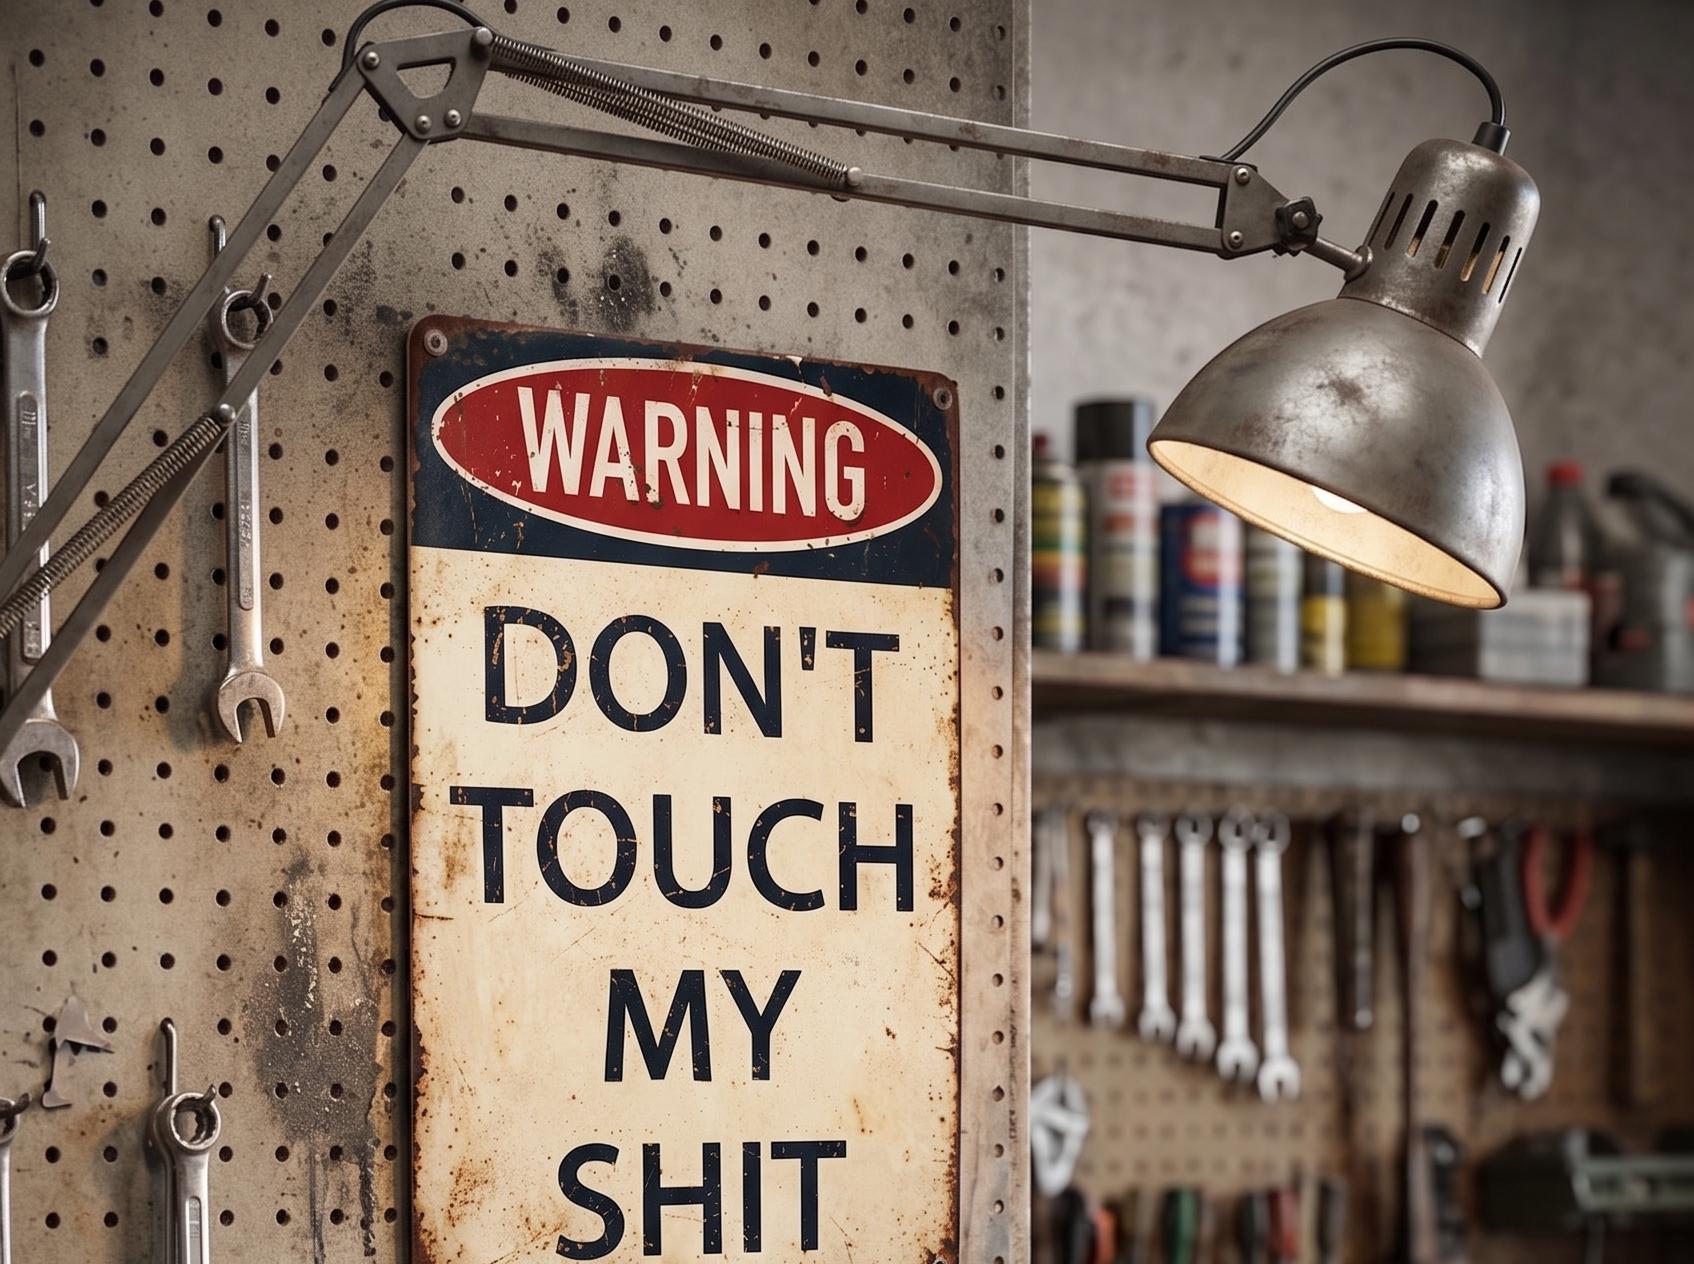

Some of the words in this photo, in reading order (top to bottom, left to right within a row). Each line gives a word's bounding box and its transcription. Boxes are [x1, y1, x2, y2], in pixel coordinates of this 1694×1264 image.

[517, 386, 866, 521] WARNING
[484, 605, 901, 743] DON'T
[449, 785, 915, 912] TOUCH
[604, 968, 802, 1082] MY
[556, 1140, 847, 1261] SHIT
